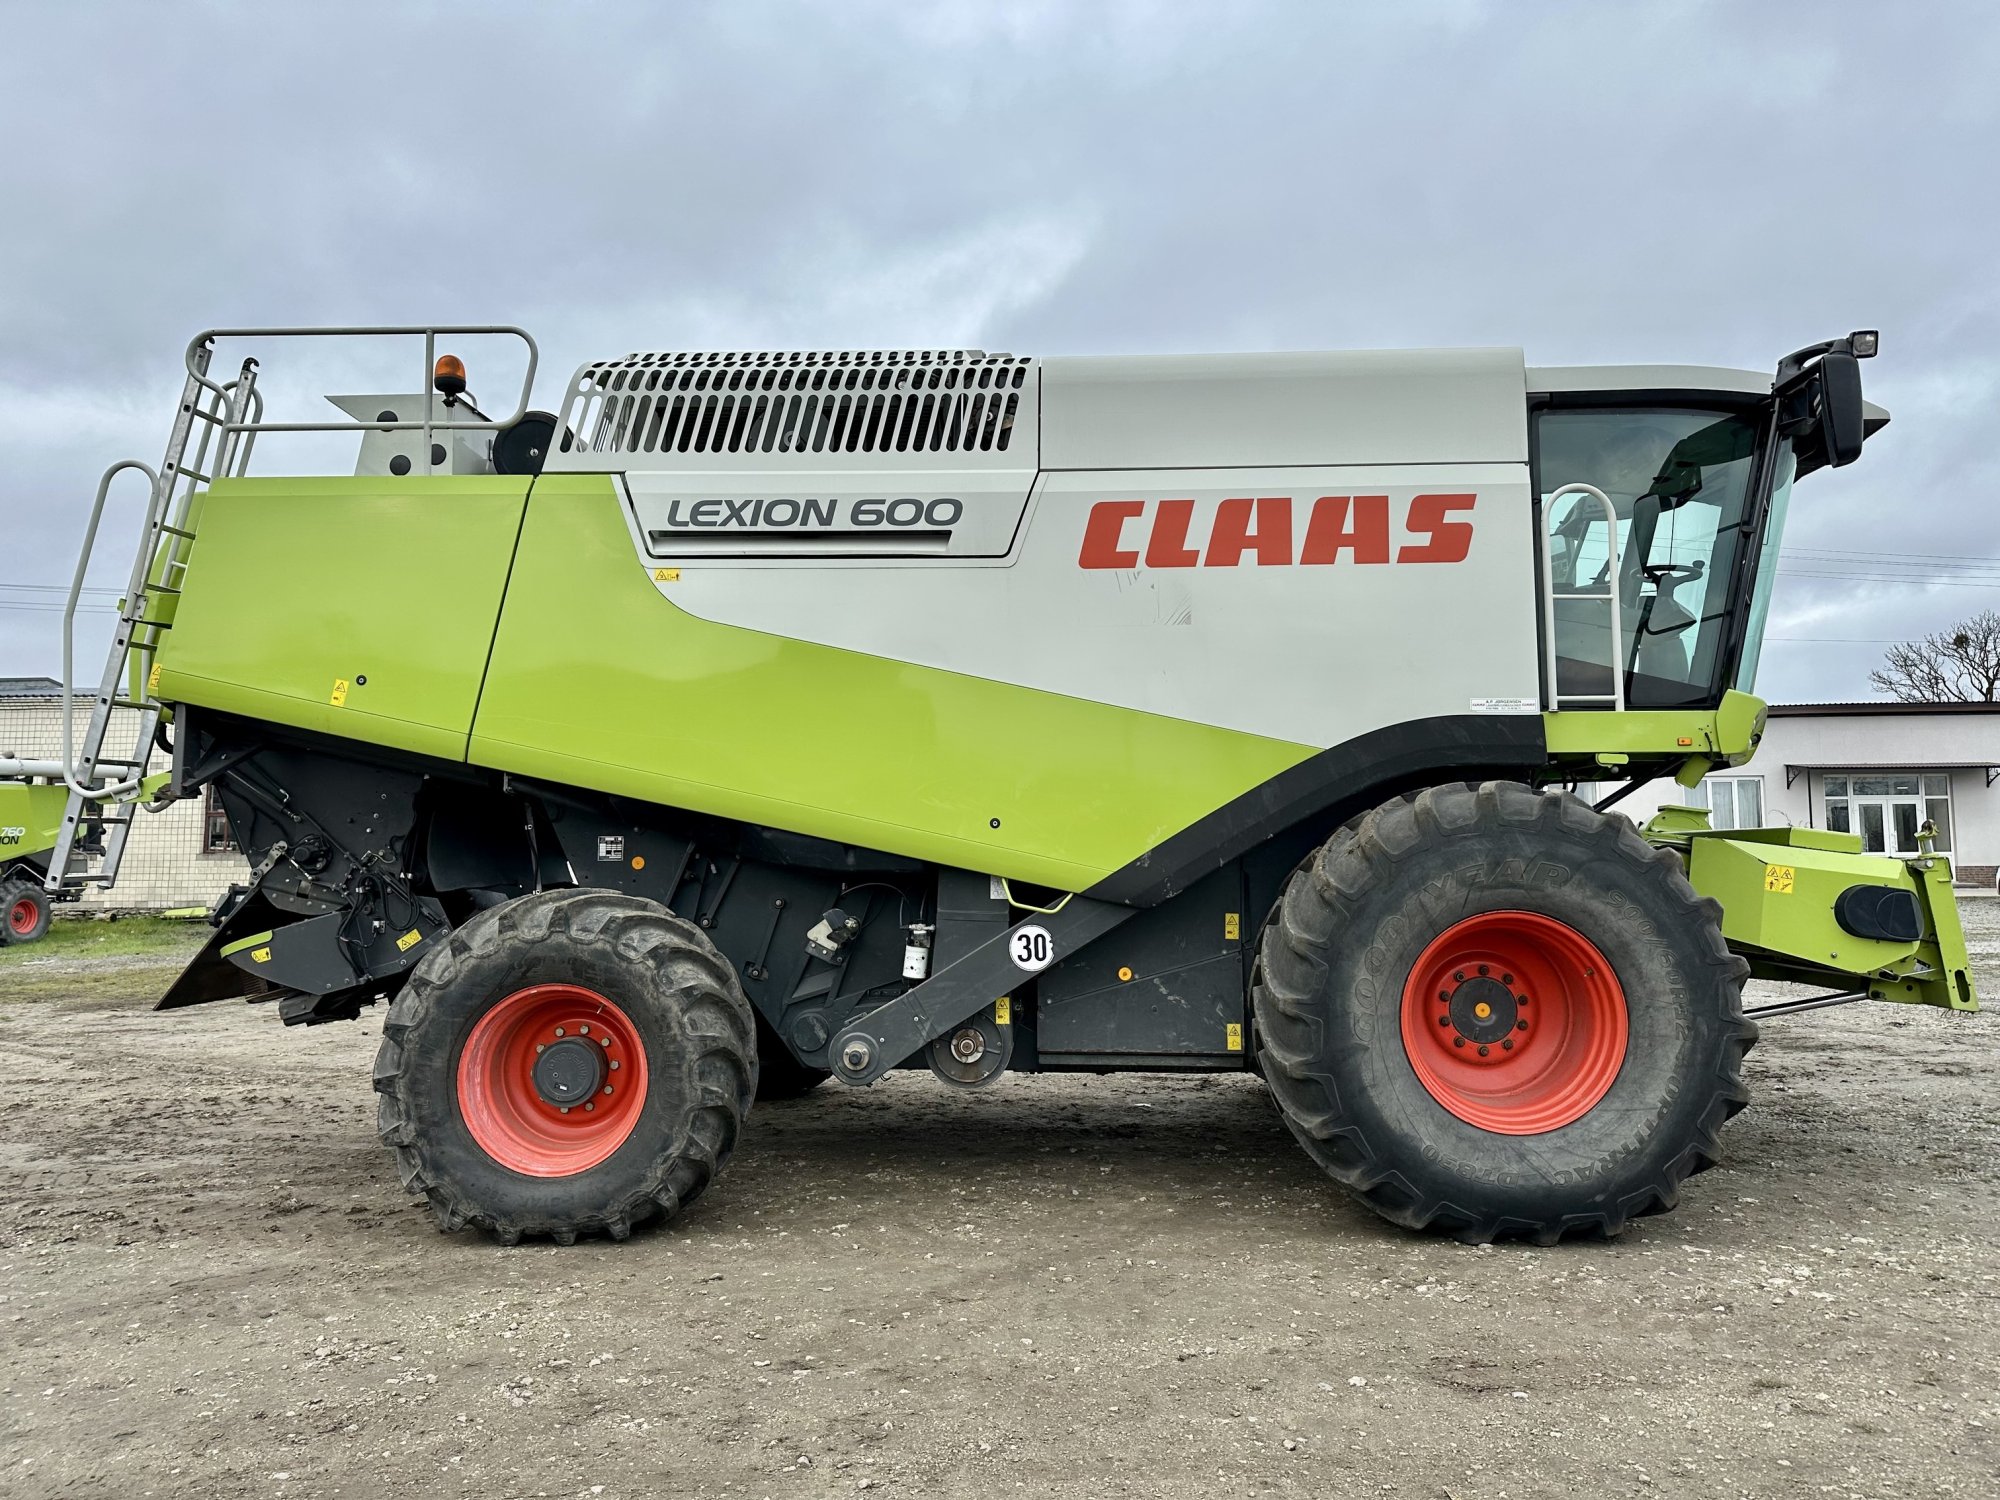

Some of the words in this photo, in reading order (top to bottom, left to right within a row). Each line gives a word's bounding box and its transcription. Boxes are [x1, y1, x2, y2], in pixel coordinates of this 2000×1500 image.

[667, 498, 838, 527] LEXION
[850, 498, 964, 526] 600
[1078, 493, 1477, 570] CLAAS
[0, 827, 26, 836] 760
[1017, 933, 1047, 962] 30
